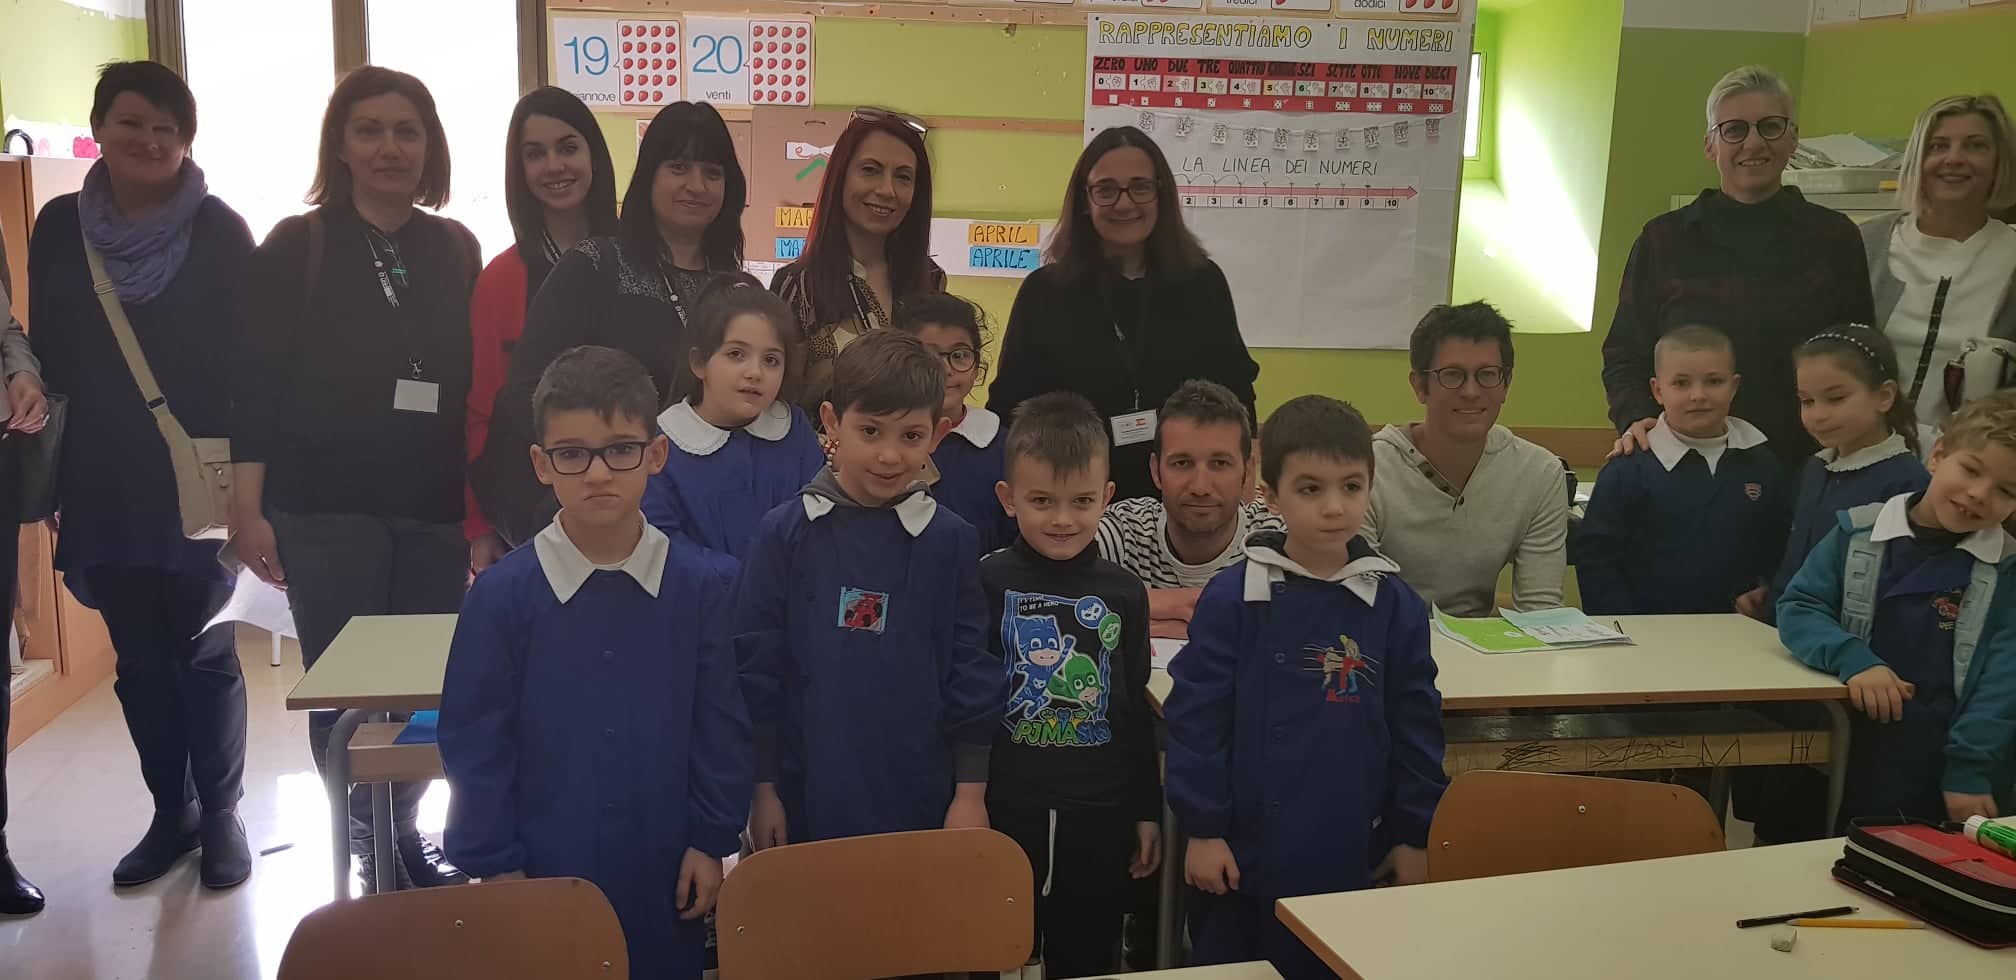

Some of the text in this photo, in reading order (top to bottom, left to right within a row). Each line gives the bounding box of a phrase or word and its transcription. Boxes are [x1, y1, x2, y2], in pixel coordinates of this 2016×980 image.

[1099, 20, 1454, 52] RAPPRESENTIAMO I NUMERI
[564, 36, 609, 76] 19
[692, 35, 743, 74] 20
[1094, 57, 1126, 71] ZERO
[1134, 58, 1158, 71] UNO
[1167, 60, 1189, 73] DUE
[1197, 60, 1220, 74] TRE
[706, 88, 731, 100] venti
[1183, 157, 1377, 176] LA LINEA DEI NUMERI
[974, 225, 1027, 243] APRIL
[780, 239, 805, 257] MA
[972, 247, 1030, 268] APRILE
